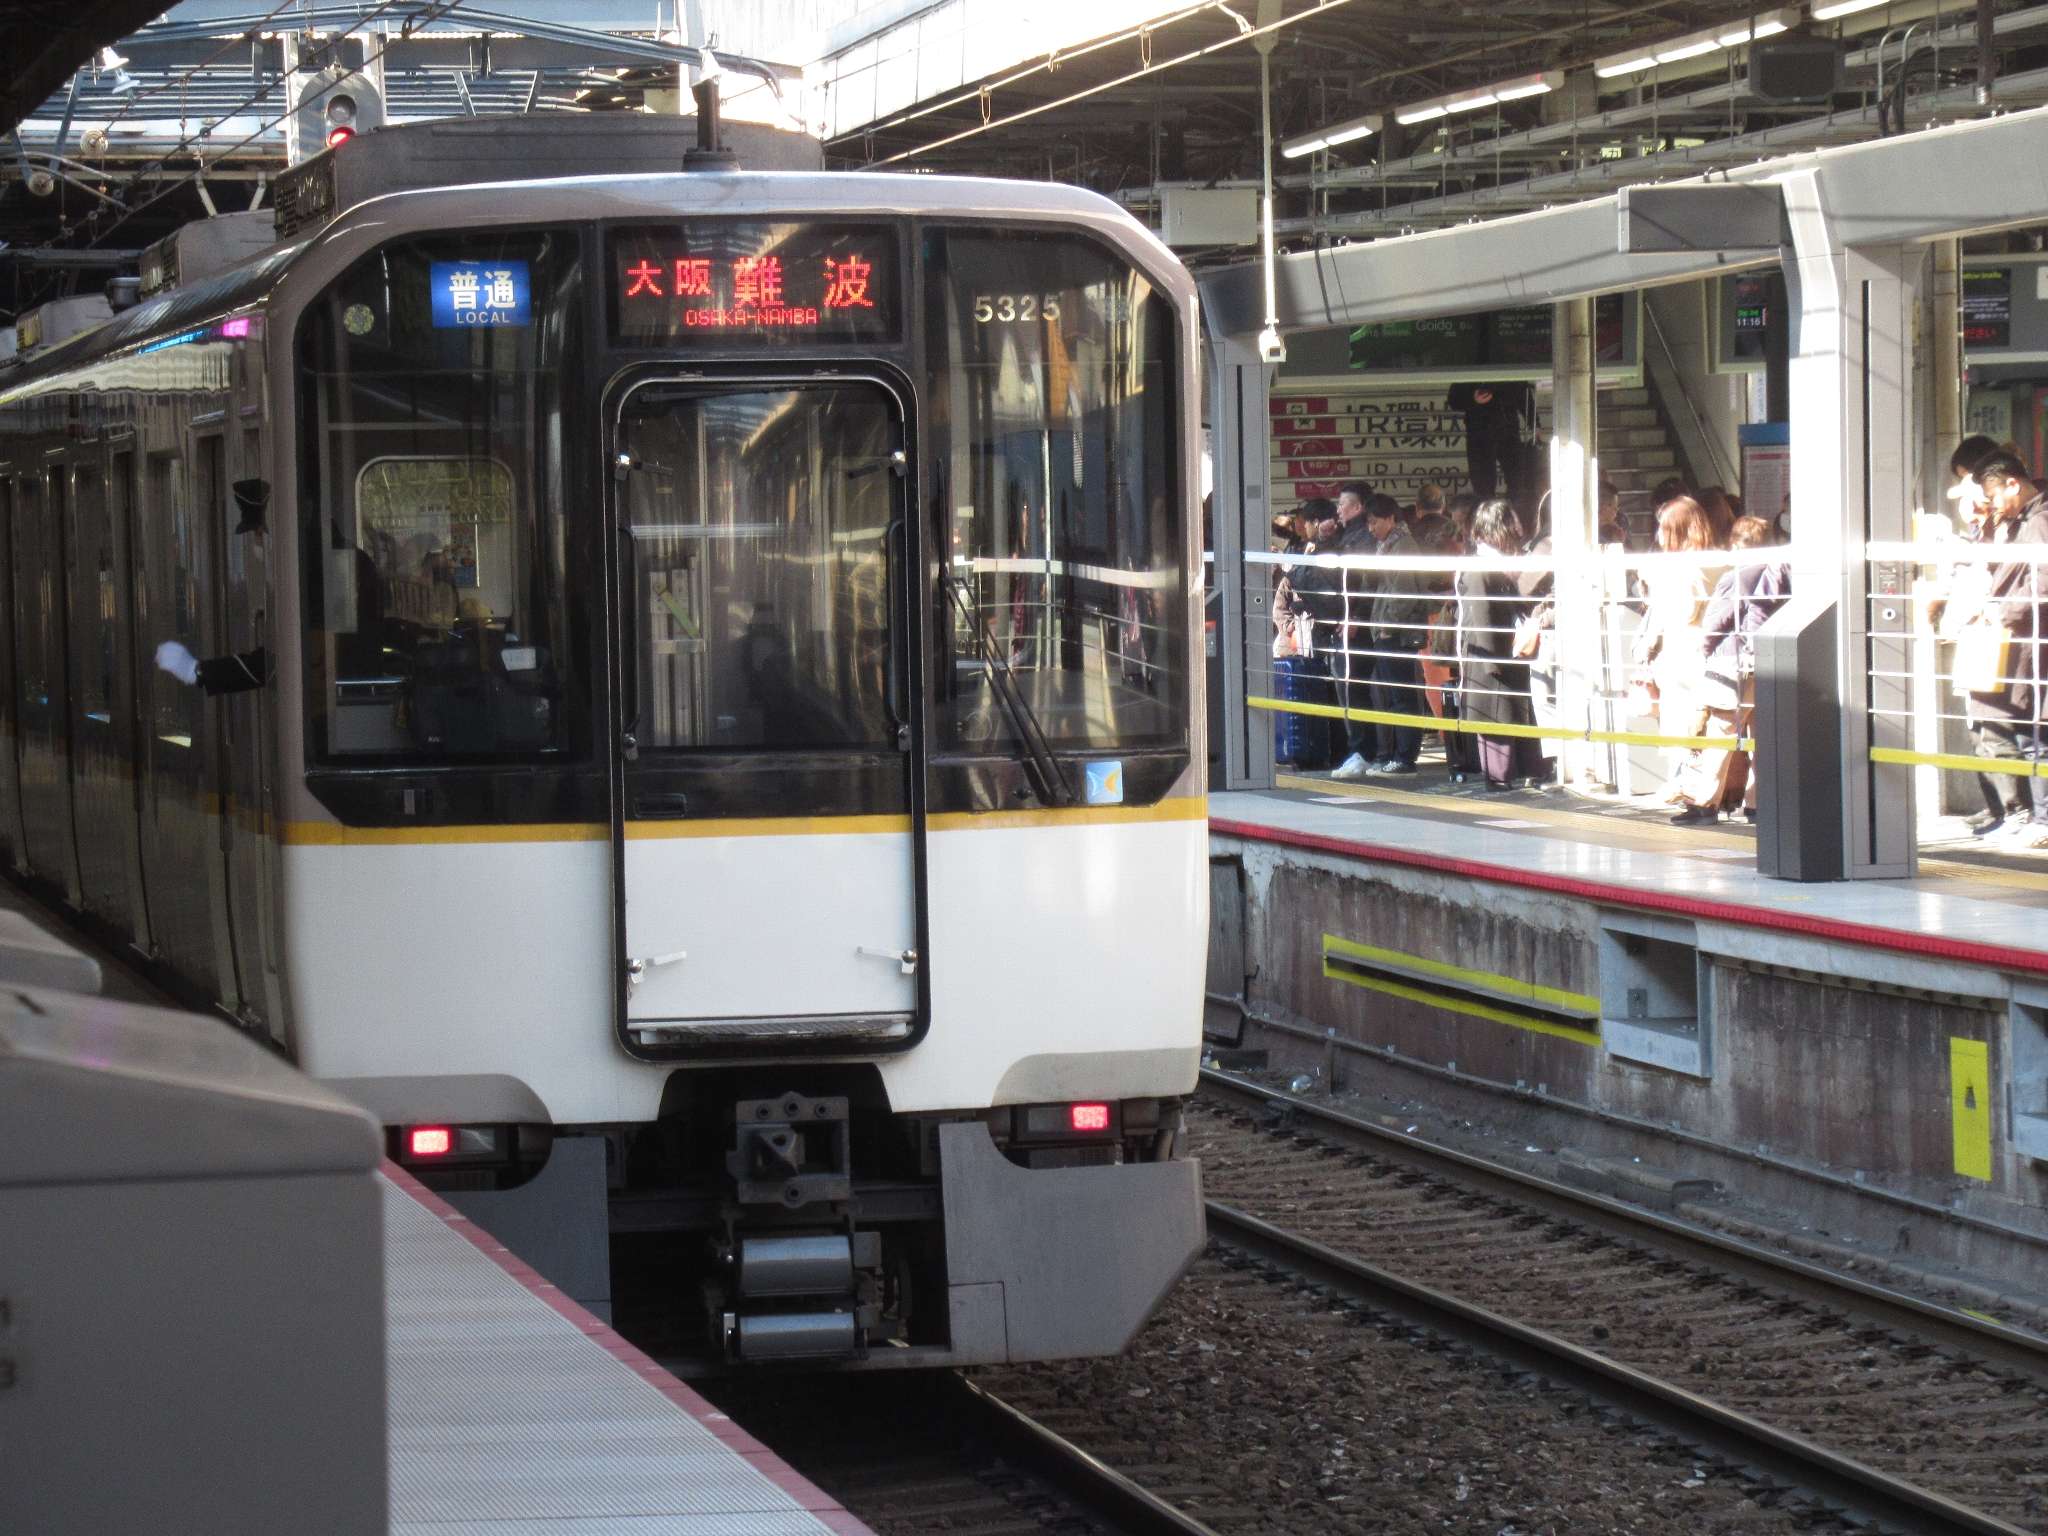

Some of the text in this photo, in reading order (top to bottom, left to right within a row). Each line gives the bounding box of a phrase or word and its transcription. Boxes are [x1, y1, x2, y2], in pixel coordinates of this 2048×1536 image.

[449, 271, 516, 310] 普通
[627, 256, 873, 307] 大阪難波
[456, 312, 510, 323] LOCAL
[685, 308, 817, 326] OSAKA-NAMBA
[974, 293, 1060, 322] 5325
